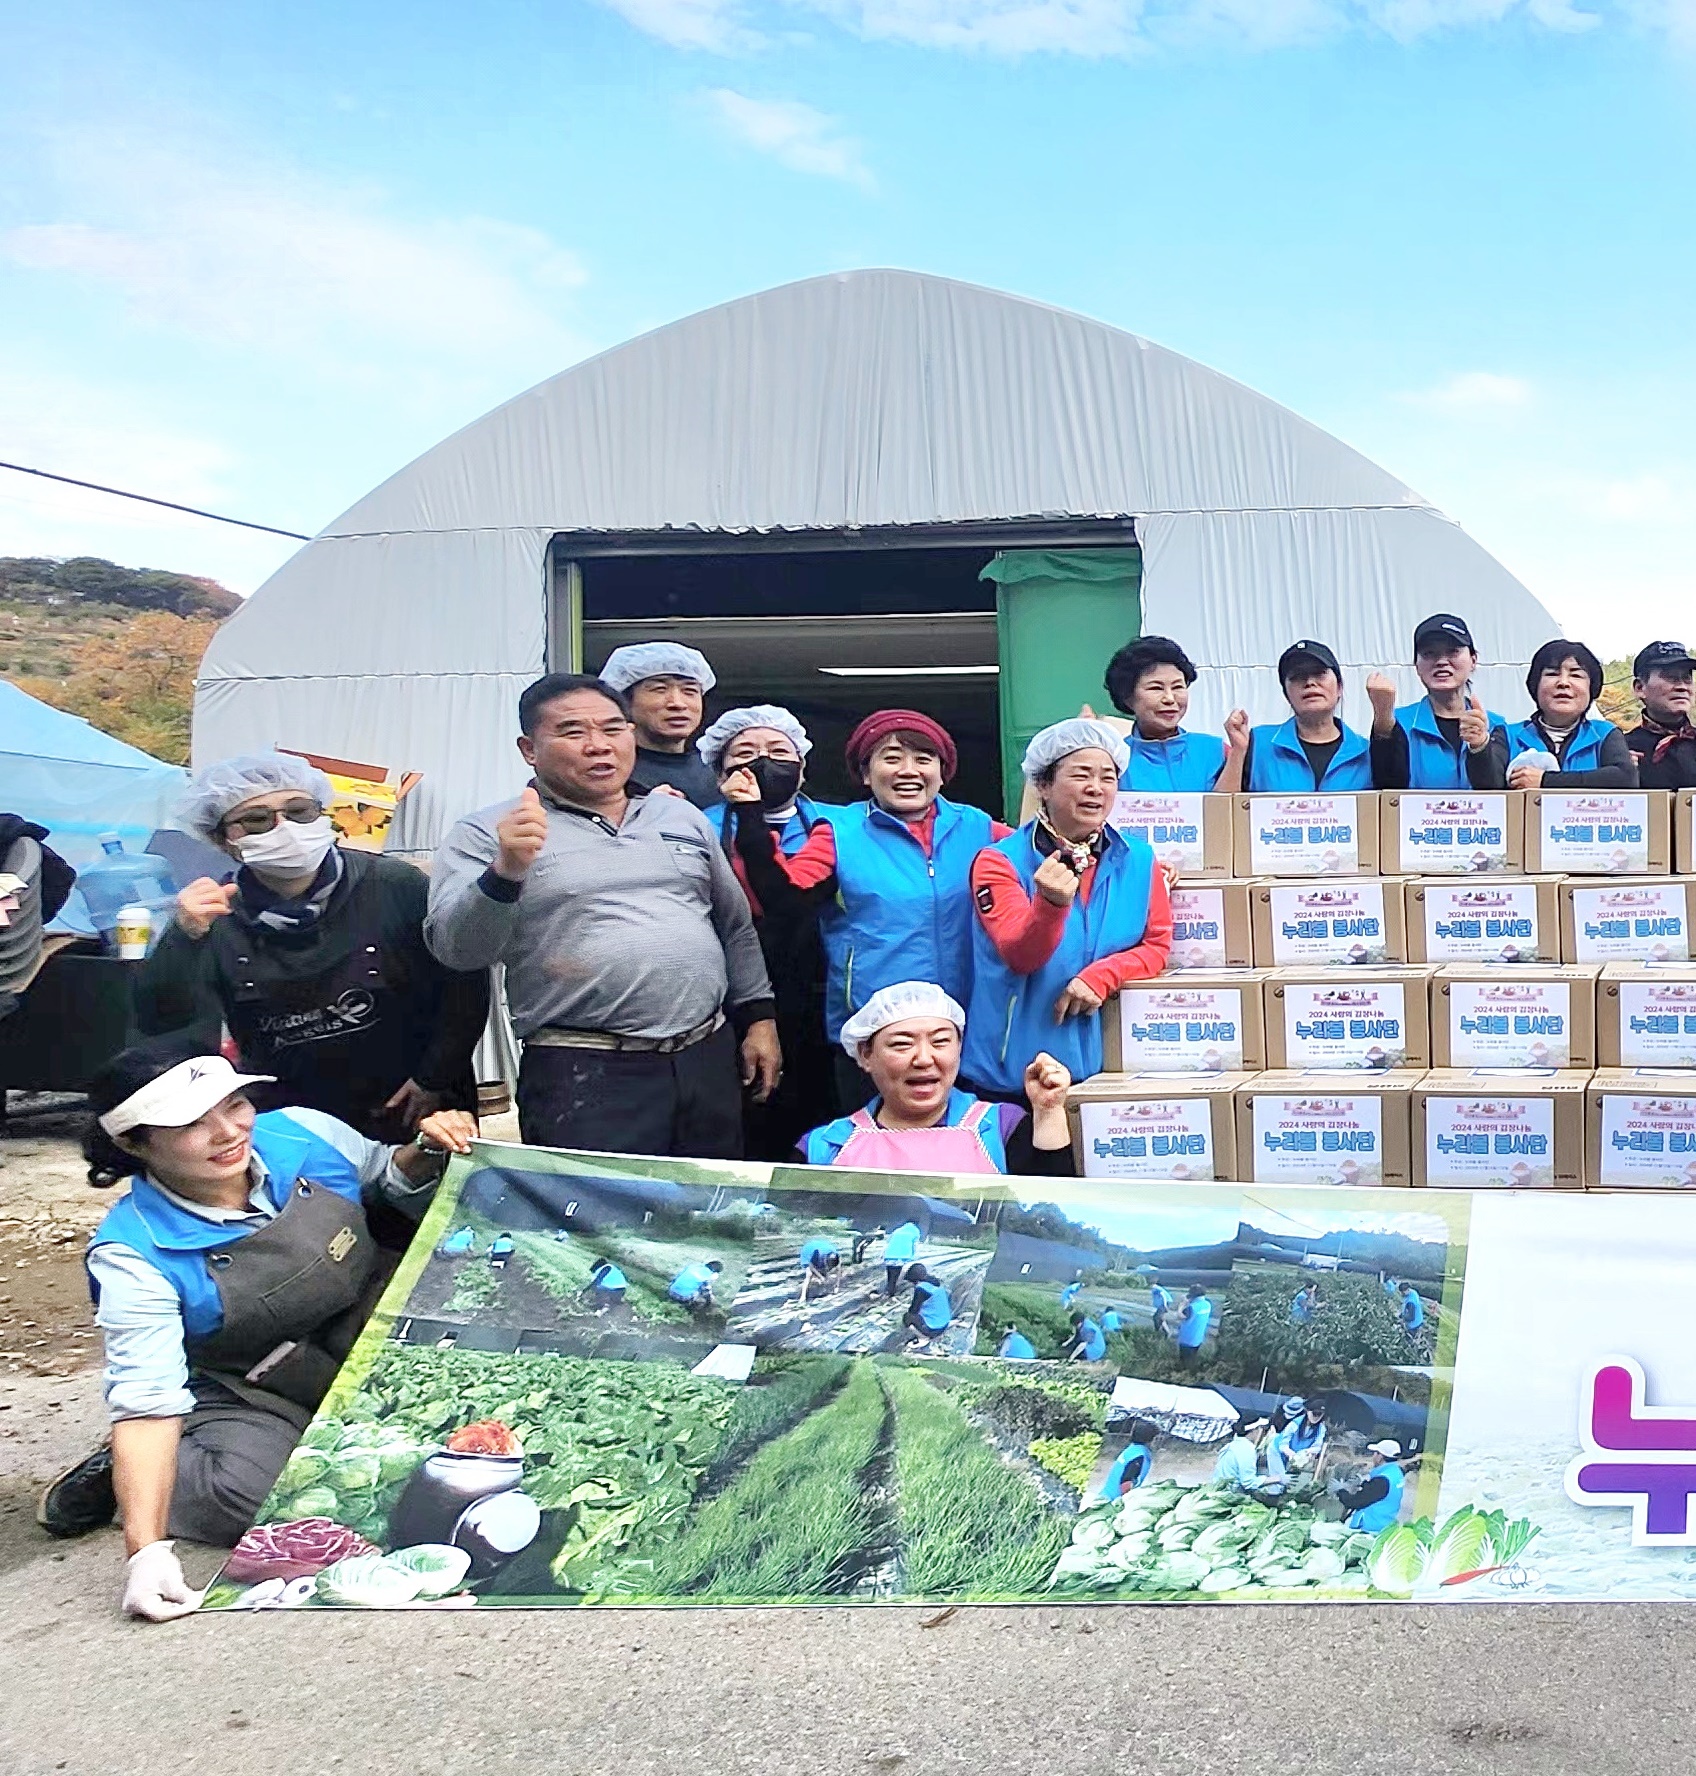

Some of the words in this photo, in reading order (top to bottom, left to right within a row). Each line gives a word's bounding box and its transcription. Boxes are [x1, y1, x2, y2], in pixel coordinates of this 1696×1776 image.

[1421, 819, 1439, 827] 2024
[1260, 828, 1303, 844] 누리봄
[1308, 826, 1352, 843] 봉사단
[1409, 828, 1453, 844] 누리봄
[1458, 828, 1502, 844] 봉사단
[1550, 826, 1594, 842] 누리봄
[1598, 826, 1642, 842] 봉사단
[1295, 911, 1314, 919] 2024
[1448, 911, 1467, 919] 2024
[1282, 920, 1329, 939] 누리봄
[1333, 918, 1380, 937] 봉사단
[1435, 920, 1482, 938] 누리봄
[1486, 920, 1533, 937] 봉사단
[1584, 920, 1630, 939] 누리봄
[1635, 918, 1682, 937] 봉사단
[1145, 1013, 1165, 1021] 2024
[1309, 1011, 1329, 1019] 2024
[1474, 1006, 1494, 1014] 2024
[1131, 1023, 1181, 1041] 누리봄
[1186, 1023, 1236, 1041] 봉사단
[1295, 1021, 1345, 1039] 누리봄
[1350, 1020, 1400, 1039] 봉사단
[1460, 1016, 1509, 1034] 누리봄
[1514, 1016, 1564, 1034] 봉사단
[1629, 1015, 1680, 1034] 누리봄
[1108, 1126, 1130, 1135] 2024
[1278, 1120, 1300, 1129] 2024
[1451, 1123, 1472, 1132] 2024
[1627, 1119, 1648, 1128] 2024
[1093, 1137, 1147, 1158] 누리봄
[1152, 1134, 1206, 1156] 봉사단
[1263, 1131, 1317, 1151] 누리봄
[1322, 1131, 1376, 1152] 봉사단
[1436, 1134, 1490, 1154] 누리봄
[1494, 1134, 1548, 1154] 봉사단
[1611, 1130, 1665, 1152] 누리봄
